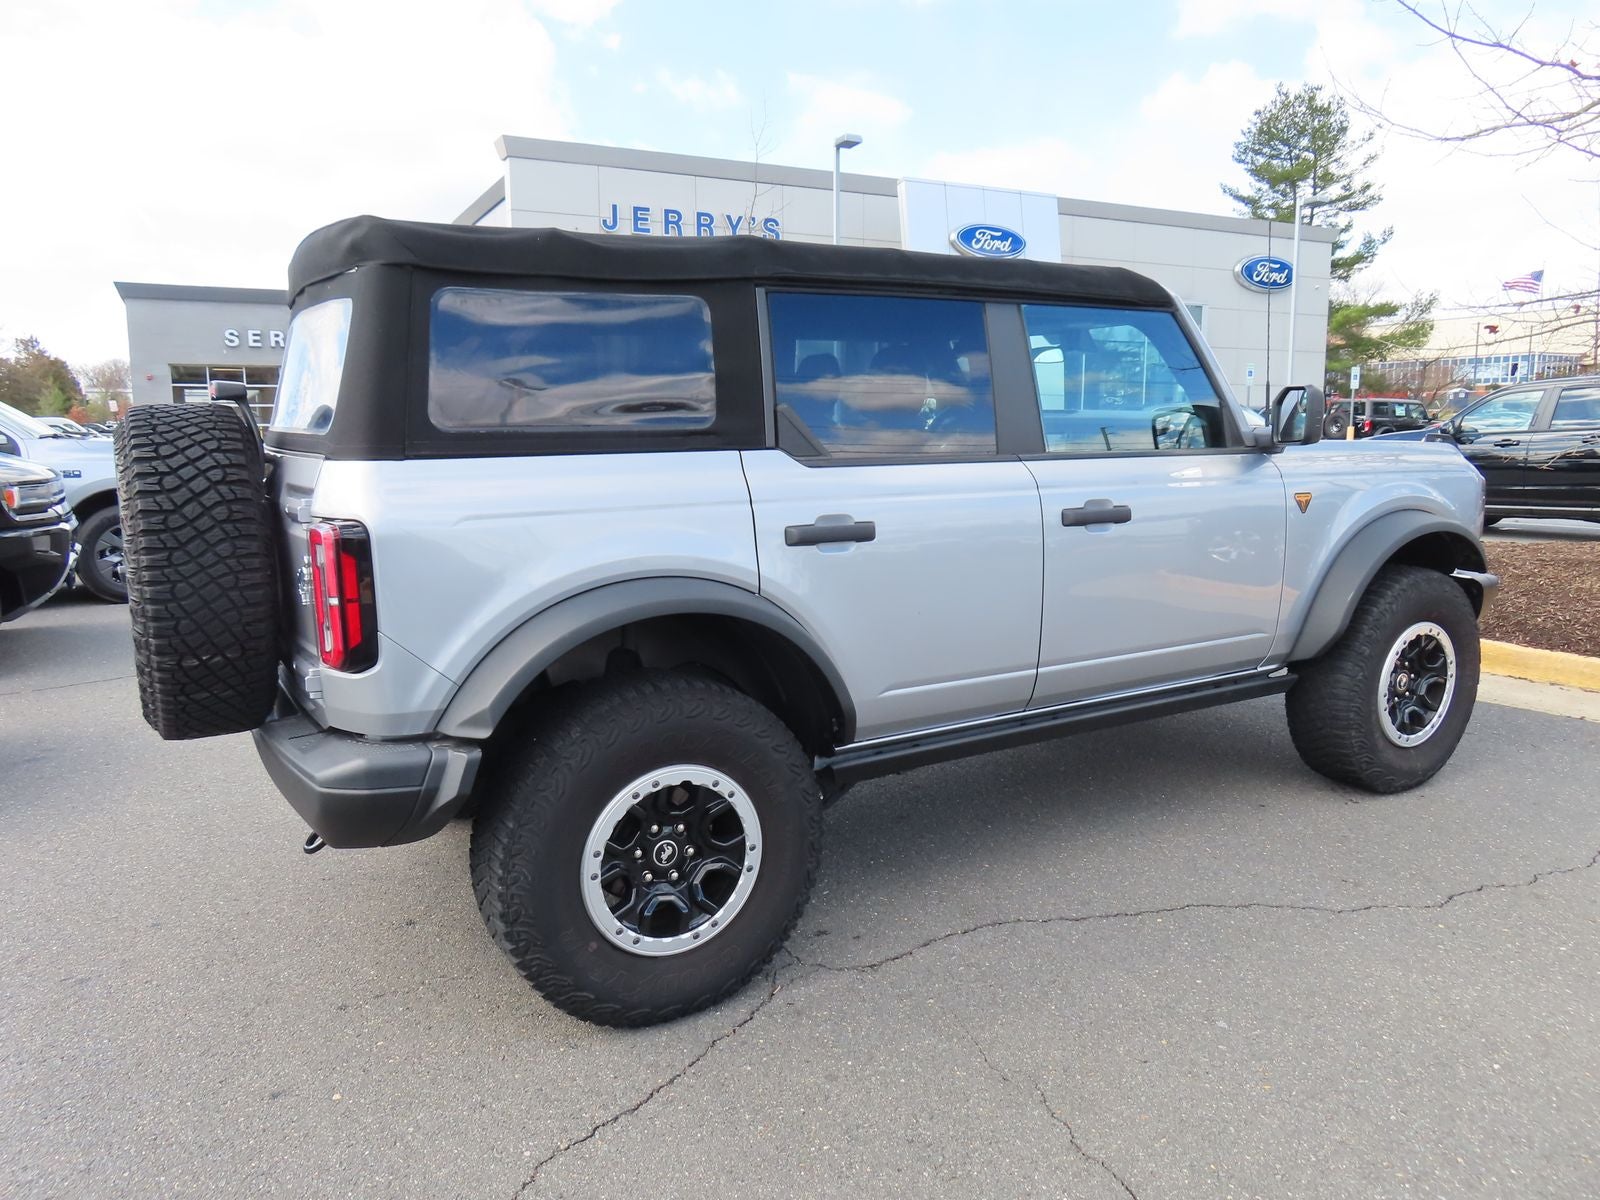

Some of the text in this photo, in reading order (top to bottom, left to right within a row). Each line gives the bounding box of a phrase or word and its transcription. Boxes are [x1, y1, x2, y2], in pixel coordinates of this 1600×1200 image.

[601, 204, 781, 240] JERRY'S
[972, 229, 1012, 252] Ford
[1252, 261, 1289, 284] Ford
